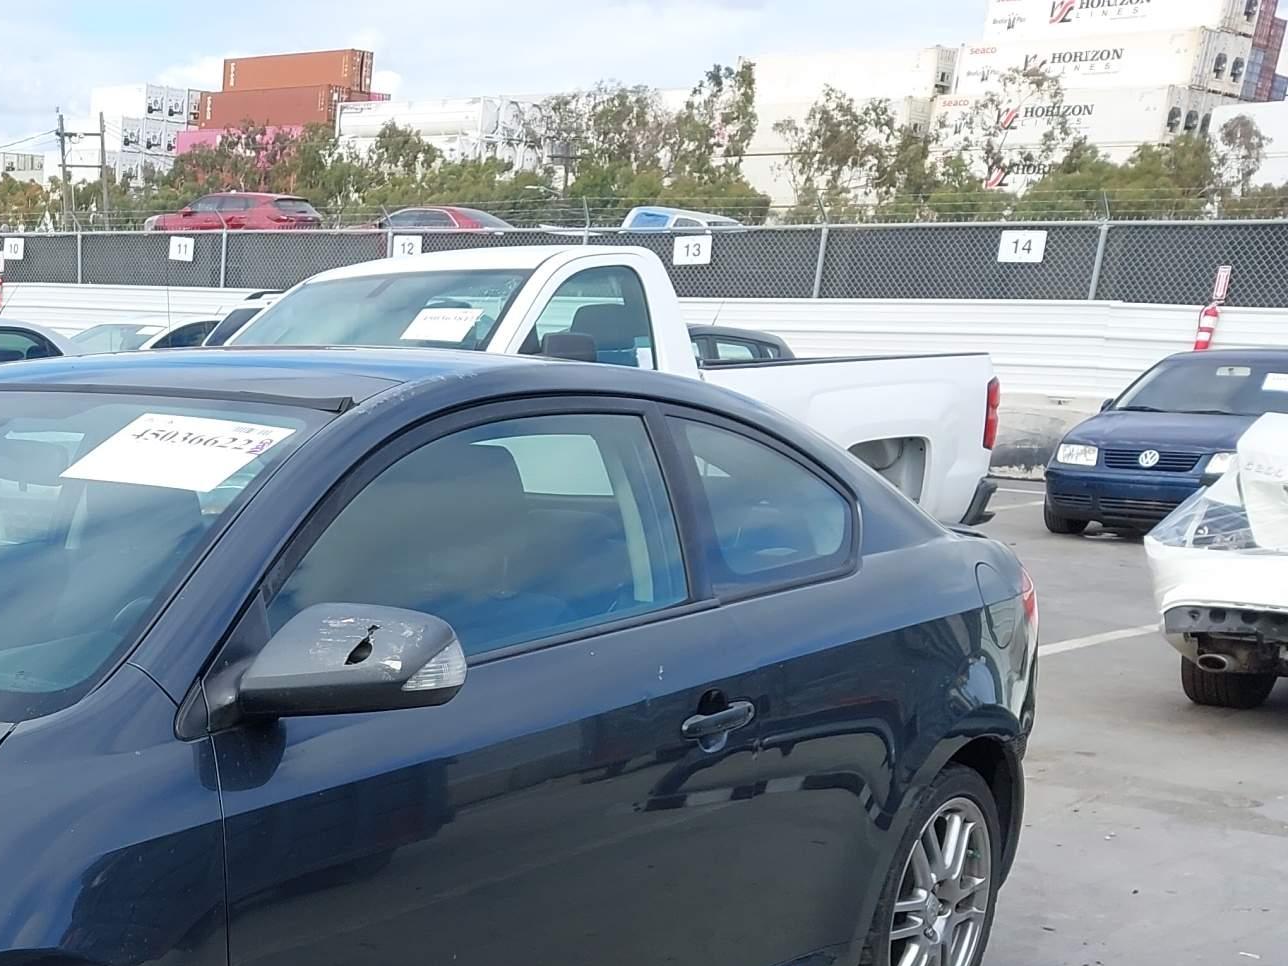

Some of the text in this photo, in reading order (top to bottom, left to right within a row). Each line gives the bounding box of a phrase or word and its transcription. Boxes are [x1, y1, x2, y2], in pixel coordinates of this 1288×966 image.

[970, 46, 997, 54] seaco
[1050, 48, 1124, 64] HORIZON
[1024, 104, 1094, 118] HORIZON
[9, 243, 19, 254] 10
[177, 243, 188, 254] 11
[400, 242, 414, 255] 12
[683, 243, 701, 257] 13
[1012, 239, 1032, 254] 14
[132, 429, 253, 450] 45036622
